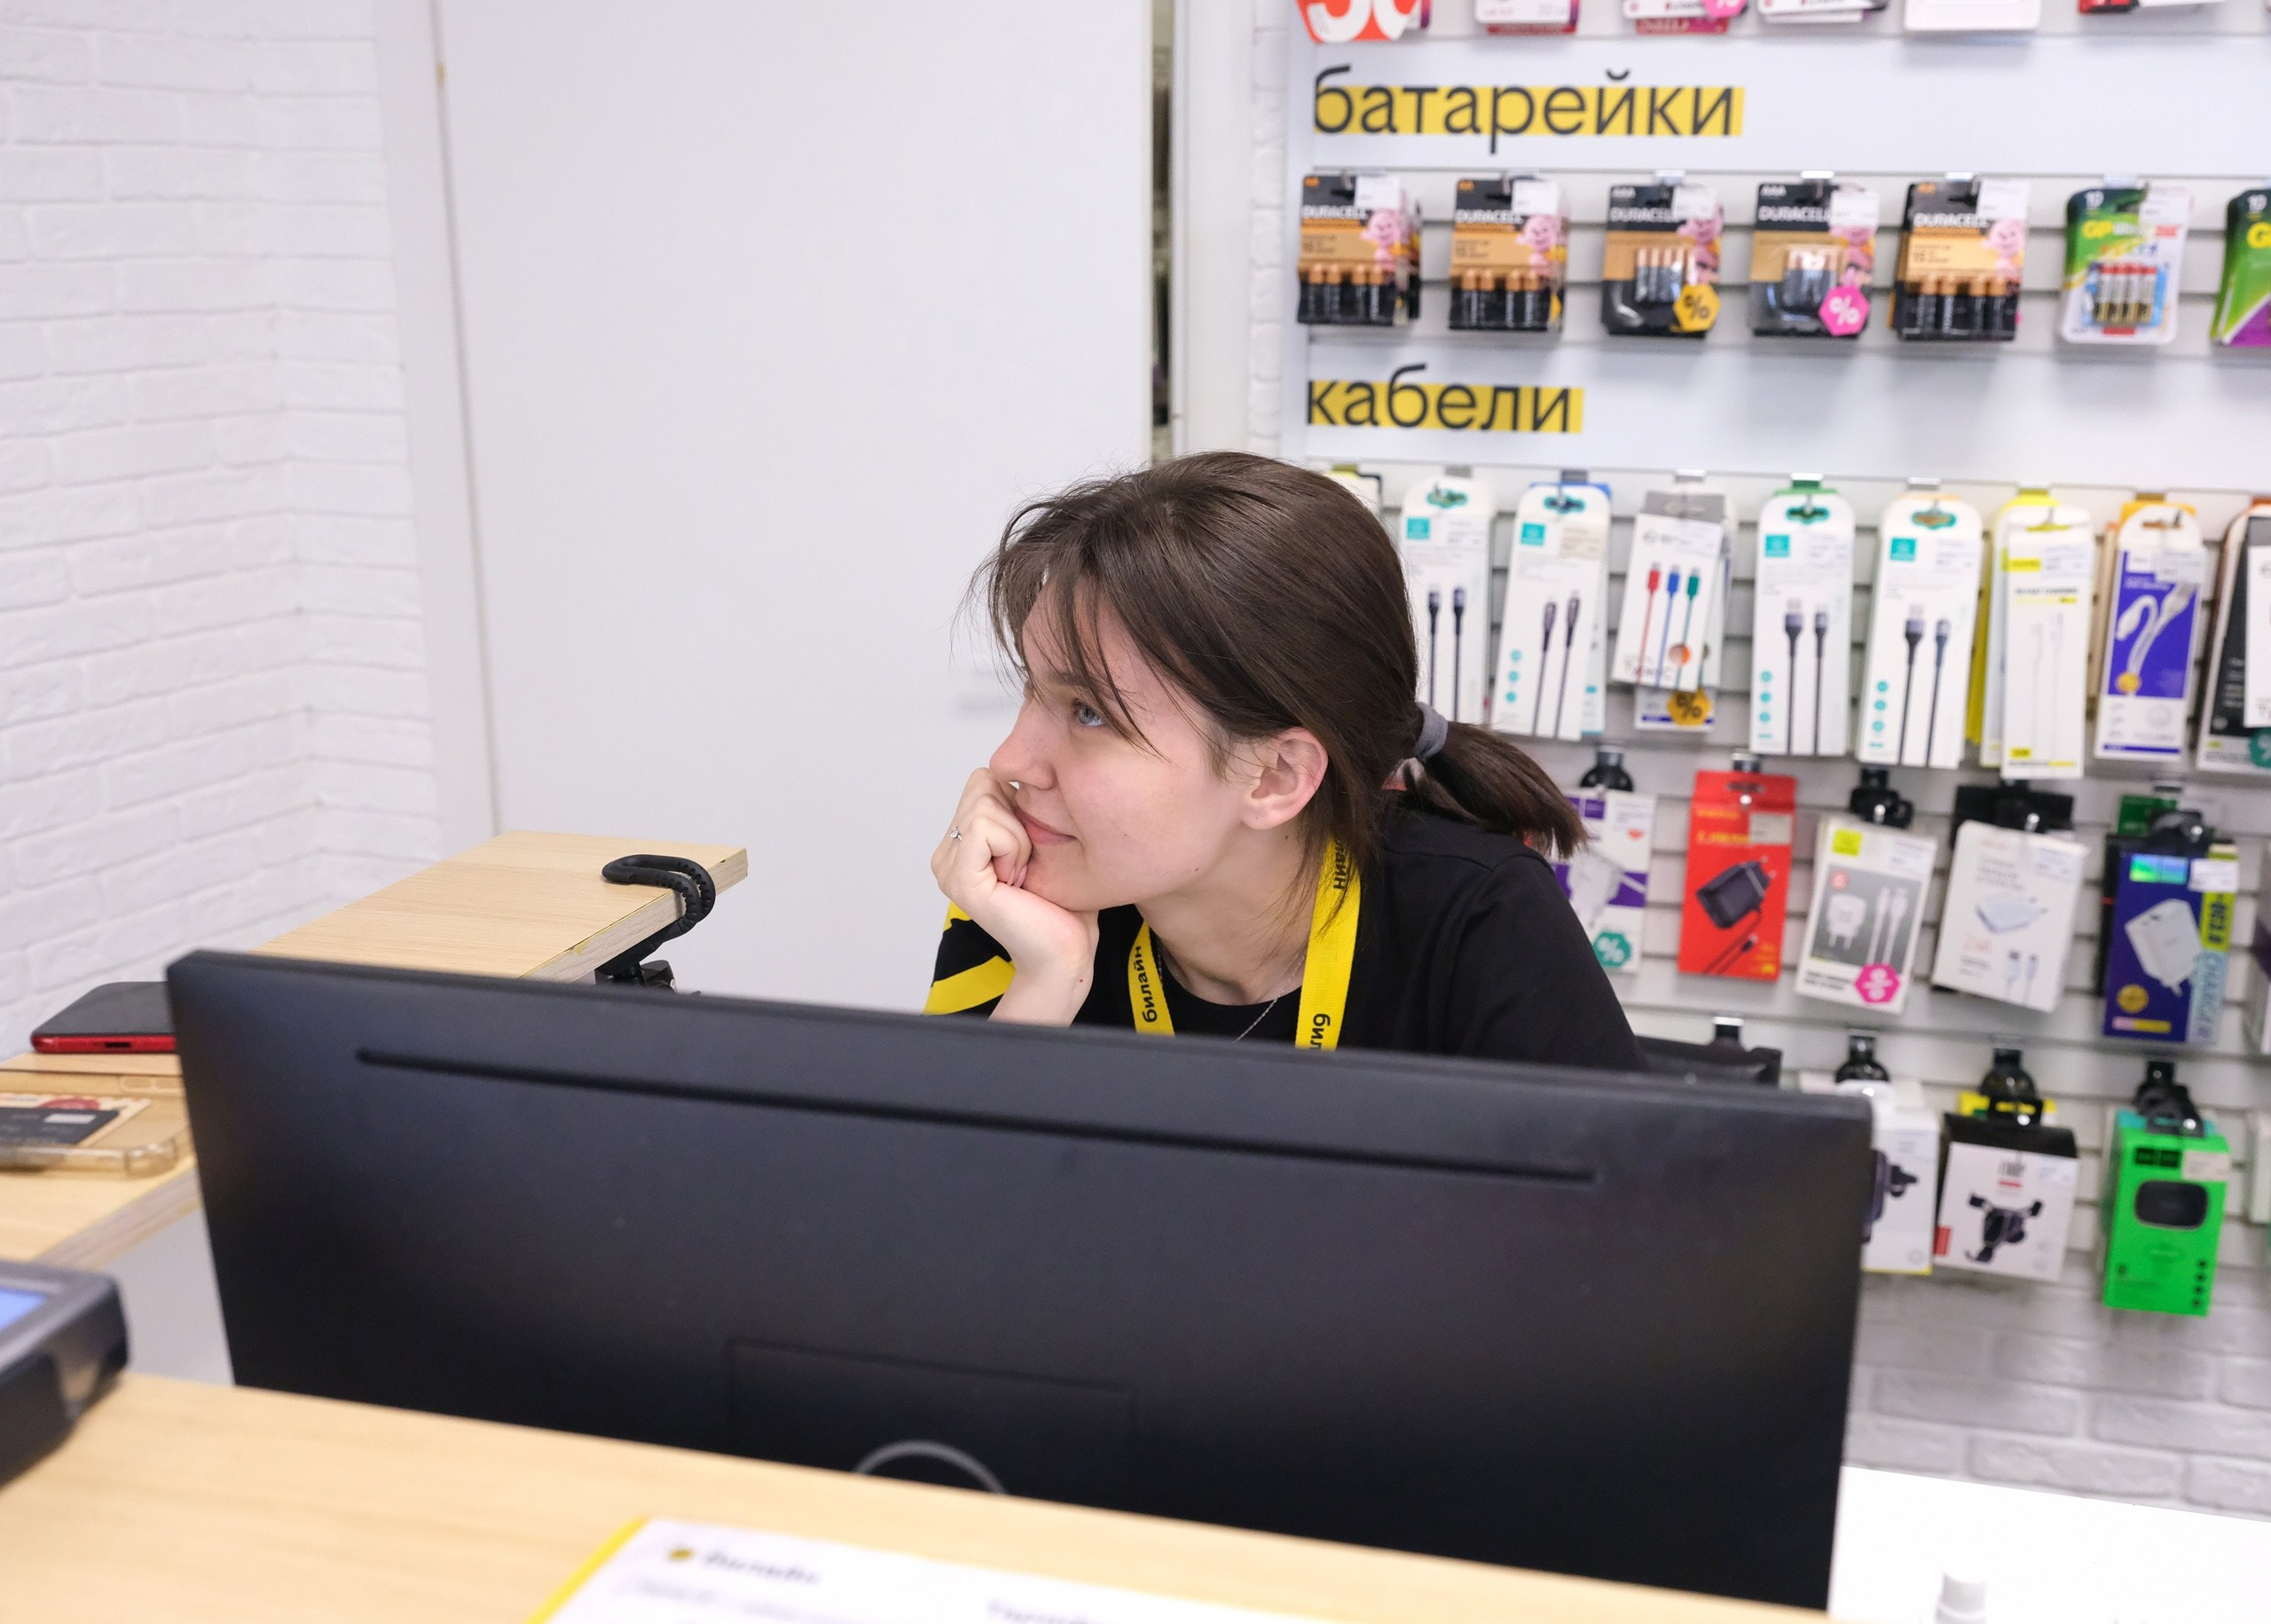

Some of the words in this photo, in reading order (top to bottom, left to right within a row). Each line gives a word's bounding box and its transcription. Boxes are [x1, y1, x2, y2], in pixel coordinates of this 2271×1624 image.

[1314, 65, 1734, 155] батарейки
[1610, 207, 1675, 223] DURACEL
[1307, 363, 1571, 433] кабели
[1133, 945, 1158, 1023] билайн
[1309, 1013, 1332, 1050] бил
